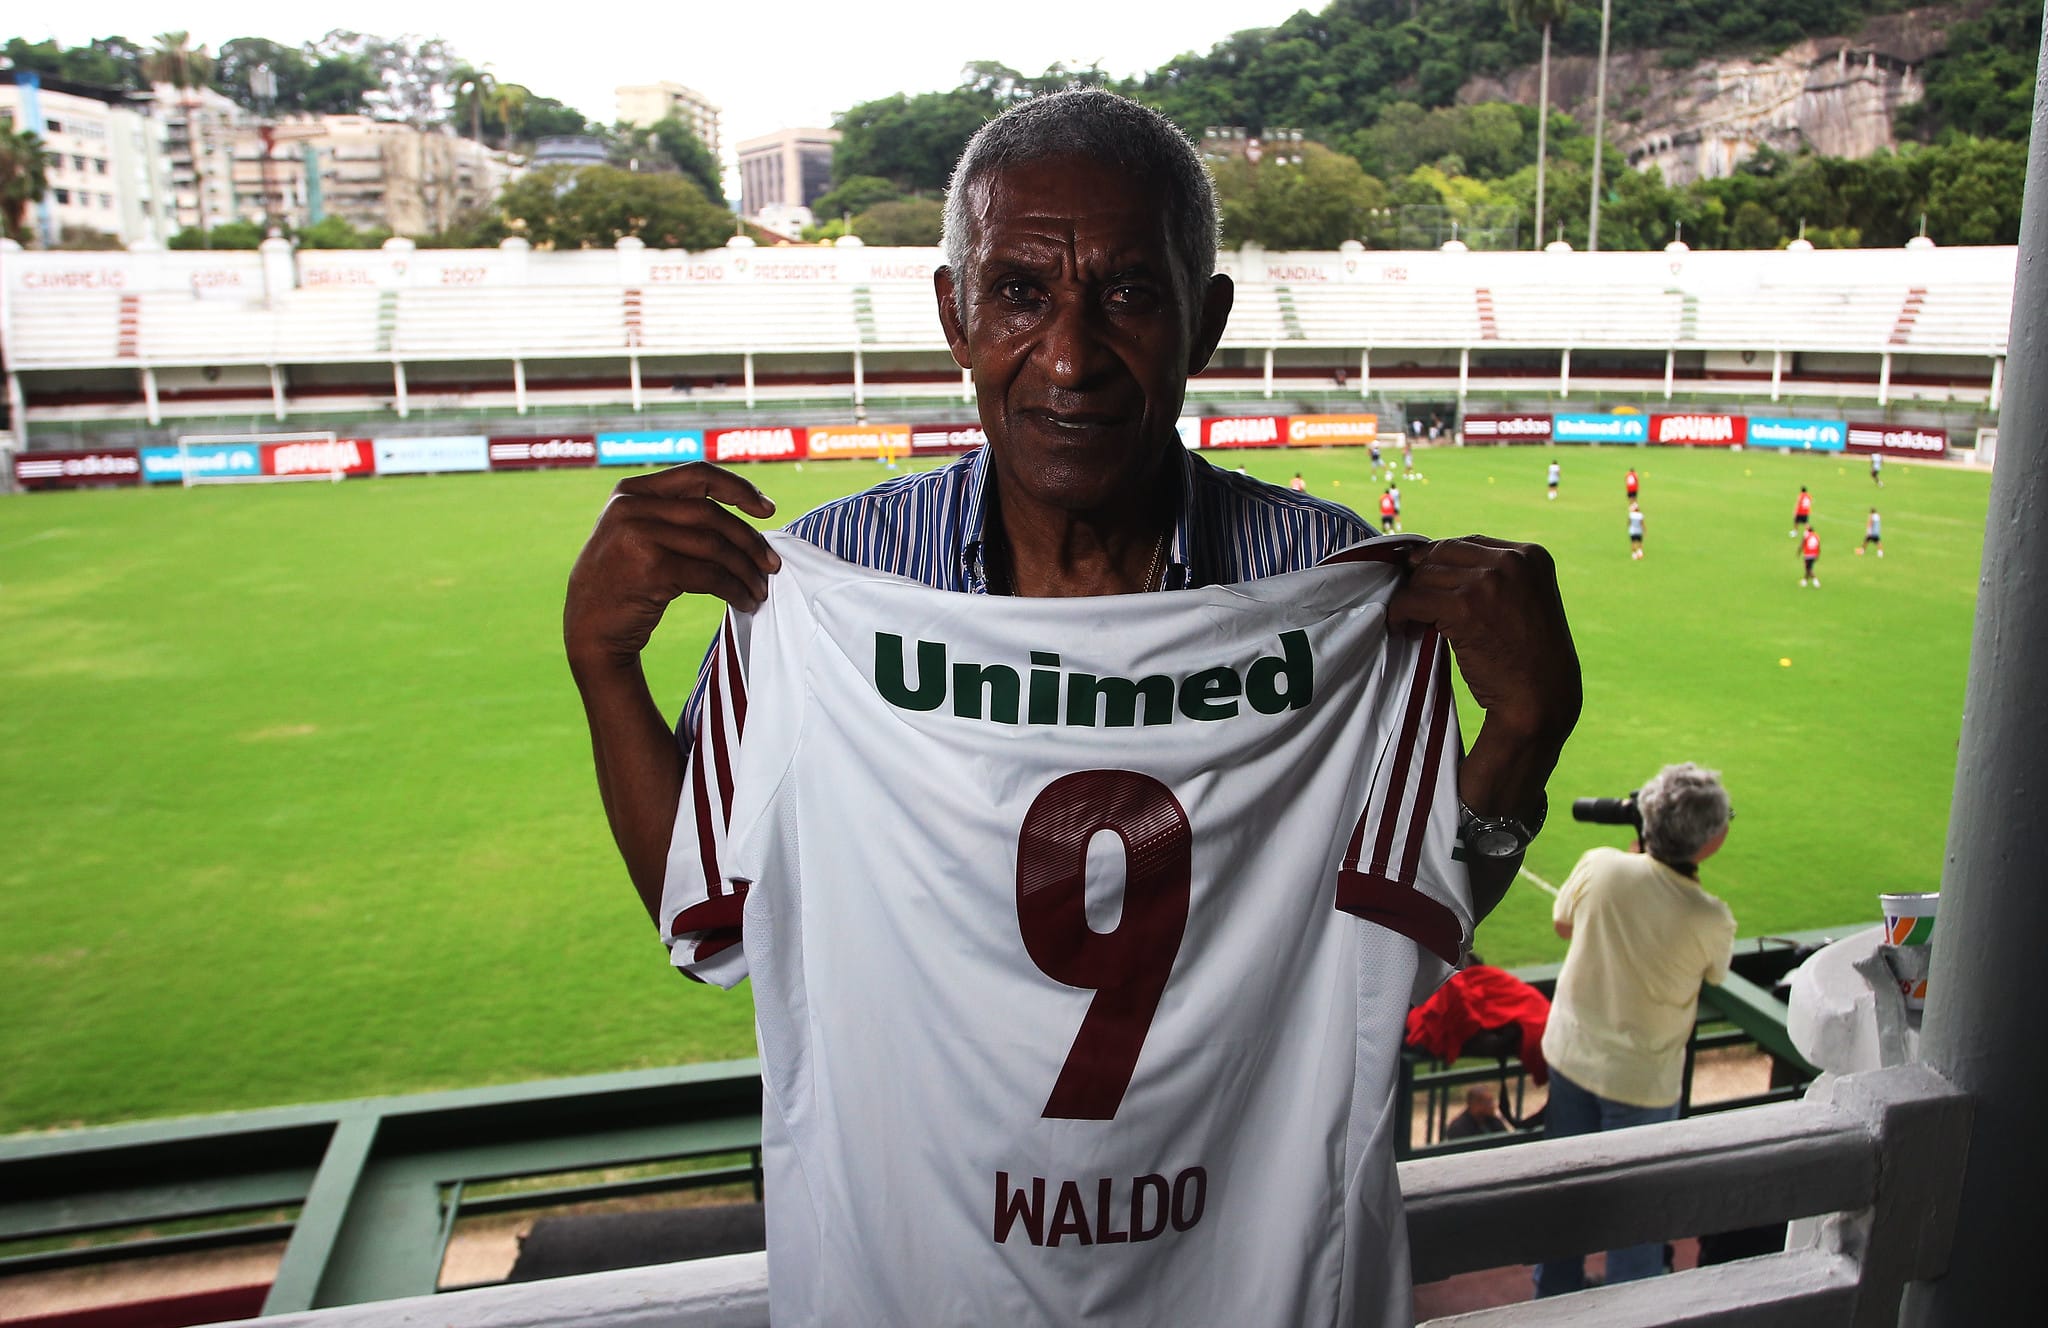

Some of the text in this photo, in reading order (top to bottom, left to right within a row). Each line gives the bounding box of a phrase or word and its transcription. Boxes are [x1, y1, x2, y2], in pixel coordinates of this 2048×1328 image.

[1498, 417, 1551, 434] adidas
[1556, 419, 1621, 435] Unimed
[1751, 423, 1818, 443] Unimed
[529, 439, 594, 459] adidas
[600, 437, 674, 457] Unimed
[1883, 430, 1945, 451] adidas
[63, 455, 139, 475] adidas
[874, 630, 1313, 728] Unimed
[1016, 769, 1193, 1121] 9
[993, 1165, 1208, 1248] WALDO
